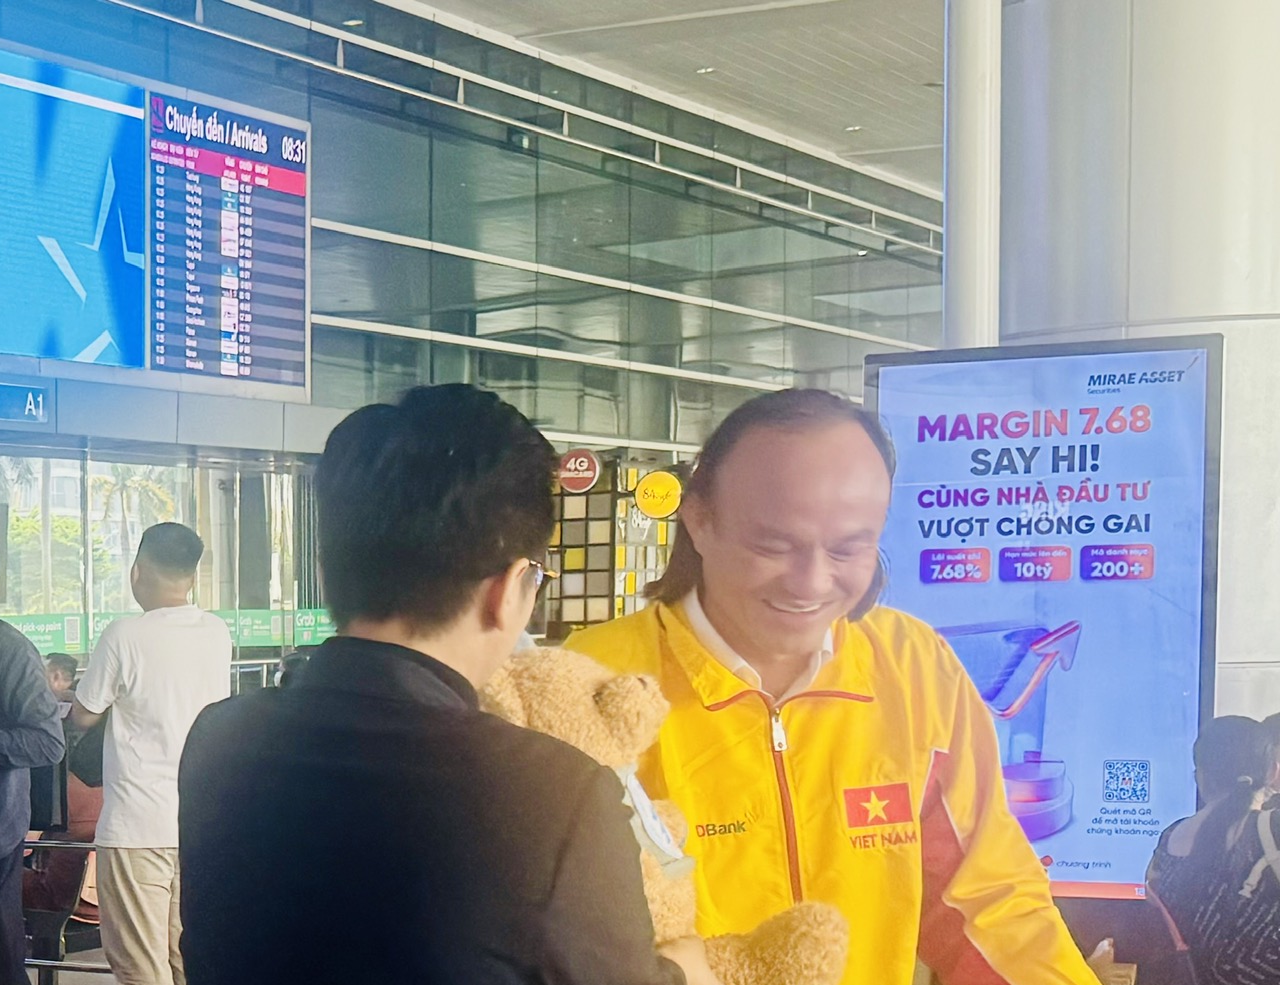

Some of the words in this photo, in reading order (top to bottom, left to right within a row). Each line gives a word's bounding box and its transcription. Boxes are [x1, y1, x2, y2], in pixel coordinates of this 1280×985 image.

[166, 105, 204, 141] Chuyến
[231, 121, 268, 154] Arrivals
[282, 136, 306, 164] 08:31
[1088, 373, 1137, 386] MIRAE
[1138, 370, 1185, 384] ASSET
[24, 392, 44, 416] A1
[917, 409, 1068, 443] MARGIN
[1079, 404, 1152, 436] 7.68
[566, 457, 589, 471] 4G
[969, 446, 1040, 477] SAY
[1051, 444, 1100, 474] HI!
[917, 483, 990, 509] CÙNG
[996, 480, 1046, 507] NHÀ
[1056, 477, 1109, 504] ĐẦU
[1116, 479, 1152, 502] TƯ
[918, 516, 990, 544] VƯỢT
[1102, 513, 1151, 534] GAI
[930, 563, 982, 579] 7.68%
[1091, 561, 1144, 577] 200+
[849, 833, 877, 849] VIET
[881, 830, 918, 848] NAM
